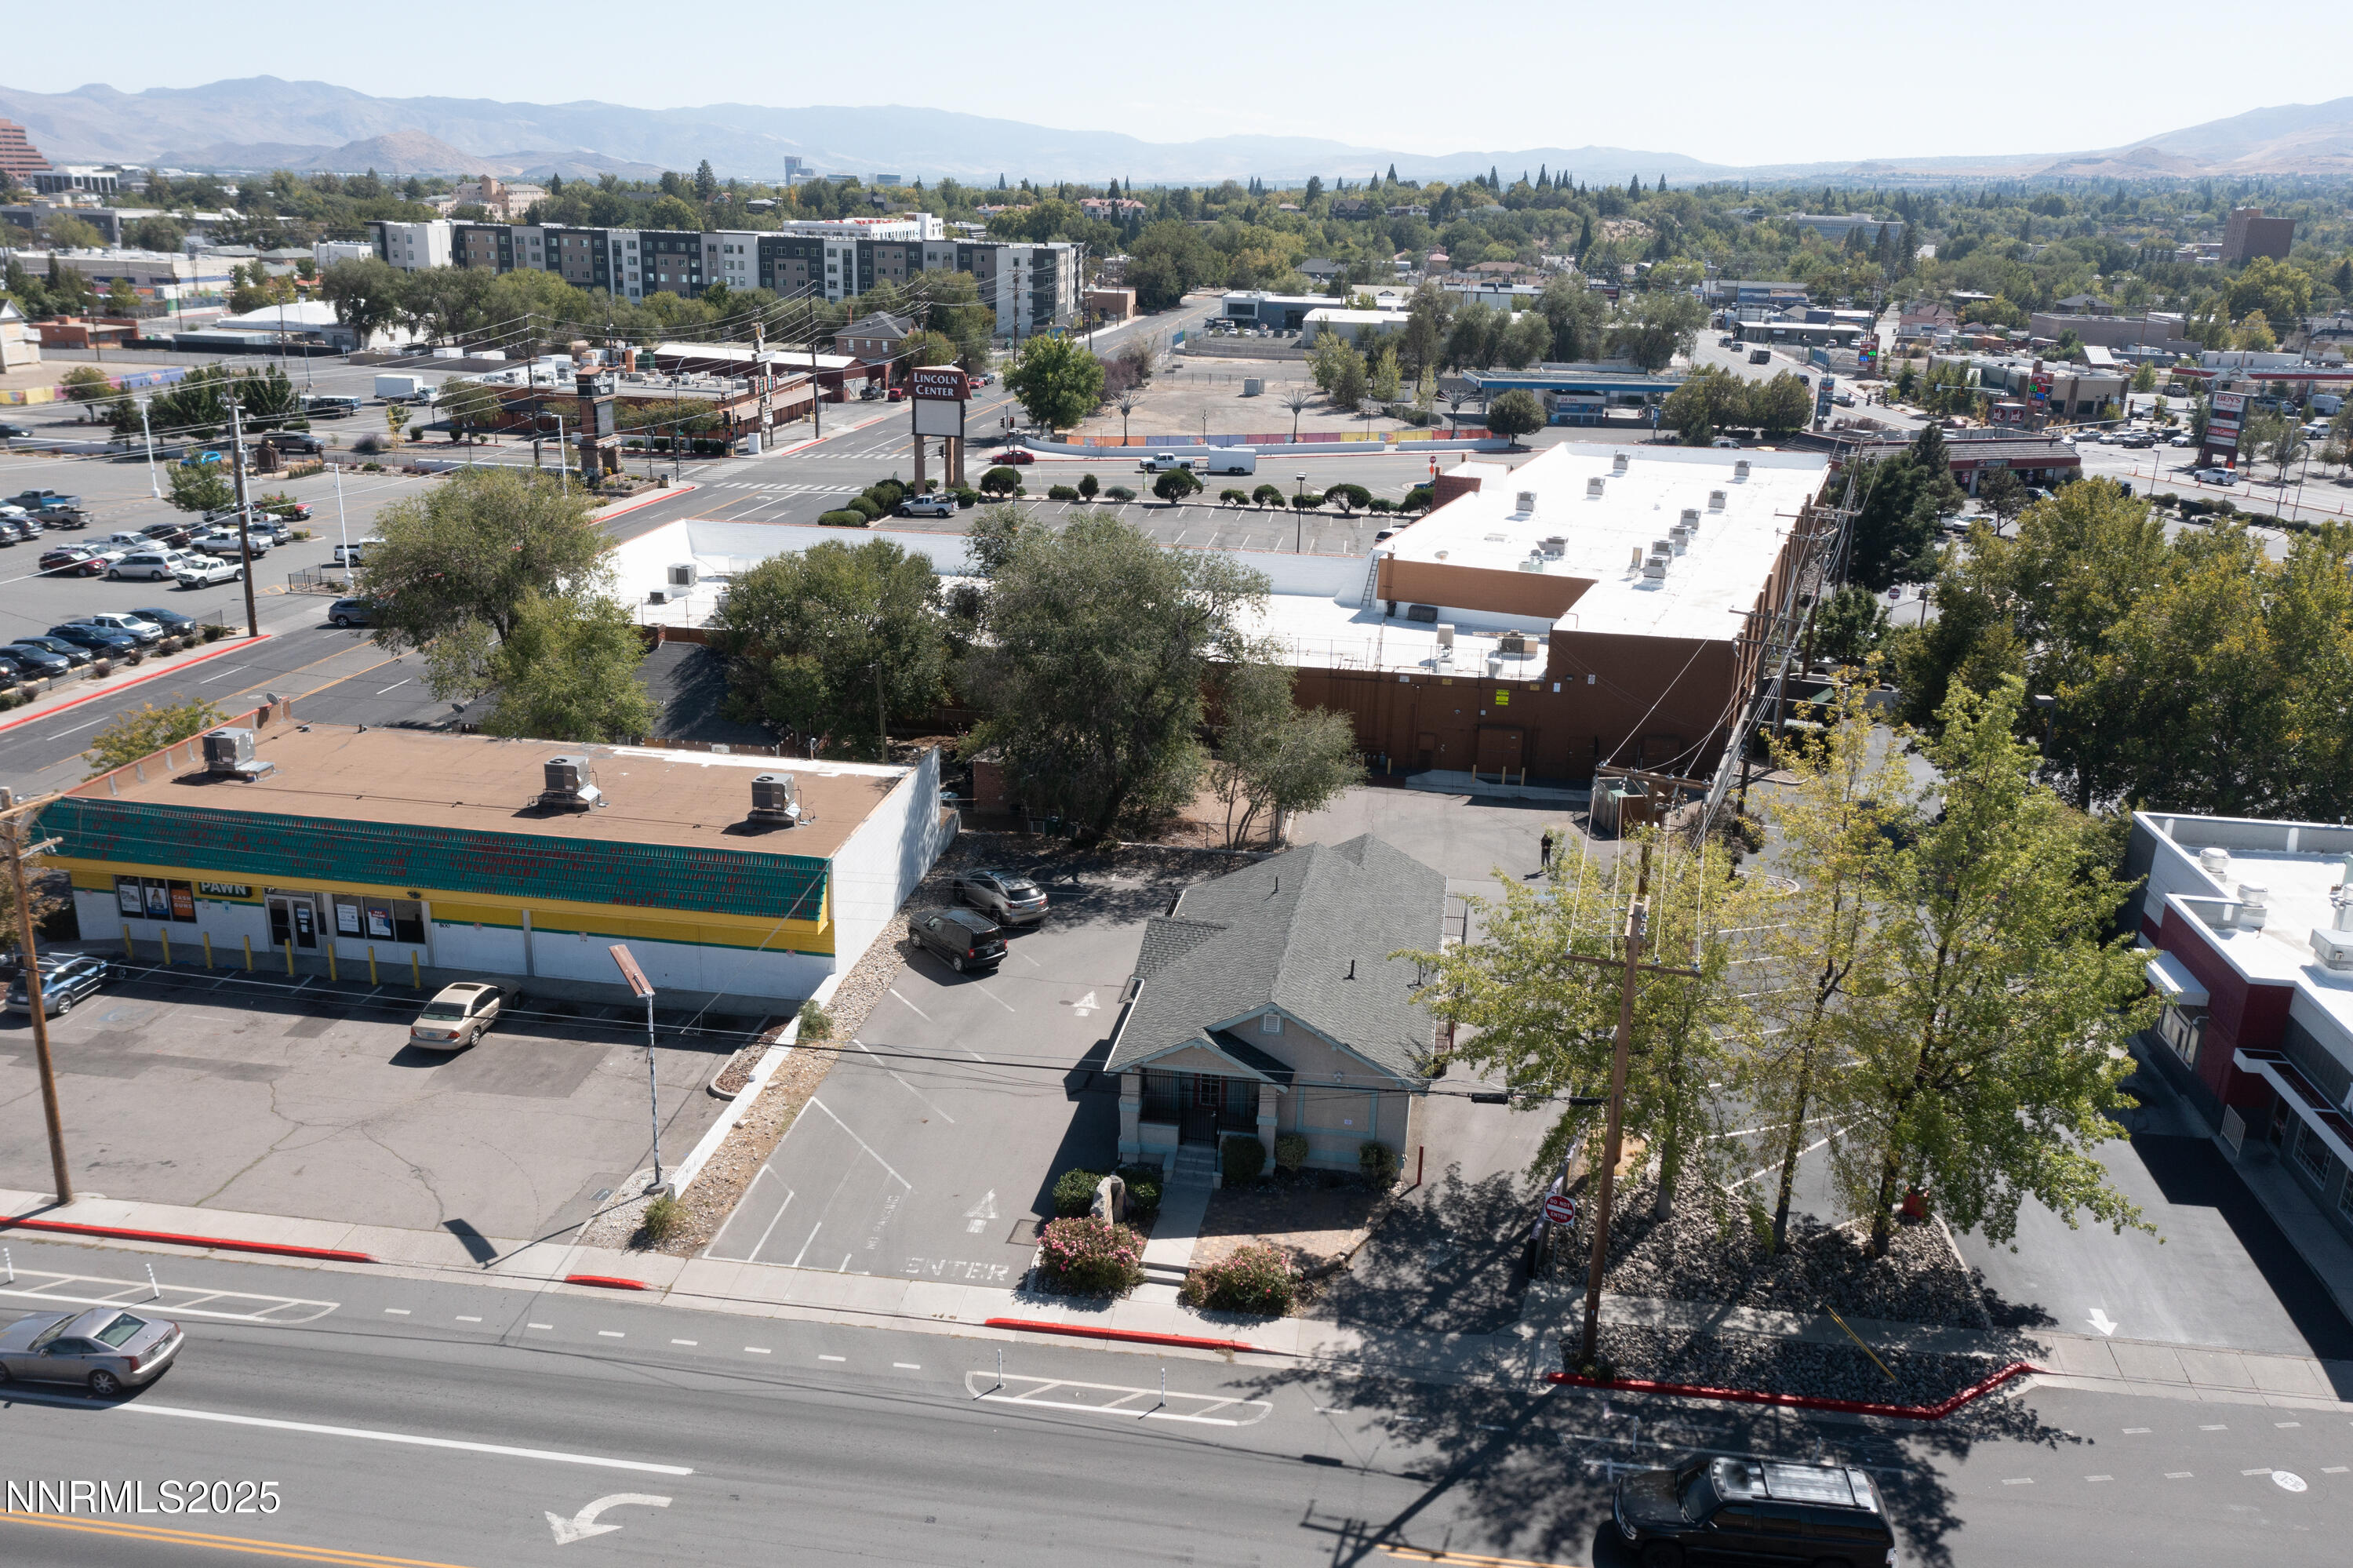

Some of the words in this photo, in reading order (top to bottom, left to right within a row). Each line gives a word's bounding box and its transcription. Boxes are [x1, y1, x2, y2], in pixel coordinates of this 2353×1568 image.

[914, 372, 958, 384] LINCOLN
[915, 384, 955, 397] CENTER
[2217, 395, 2242, 403] BEN'S
[200, 881, 247, 895] PAWN
[1550, 1211, 1568, 1221] ENTER
[900, 1256, 1010, 1282] ENTER
